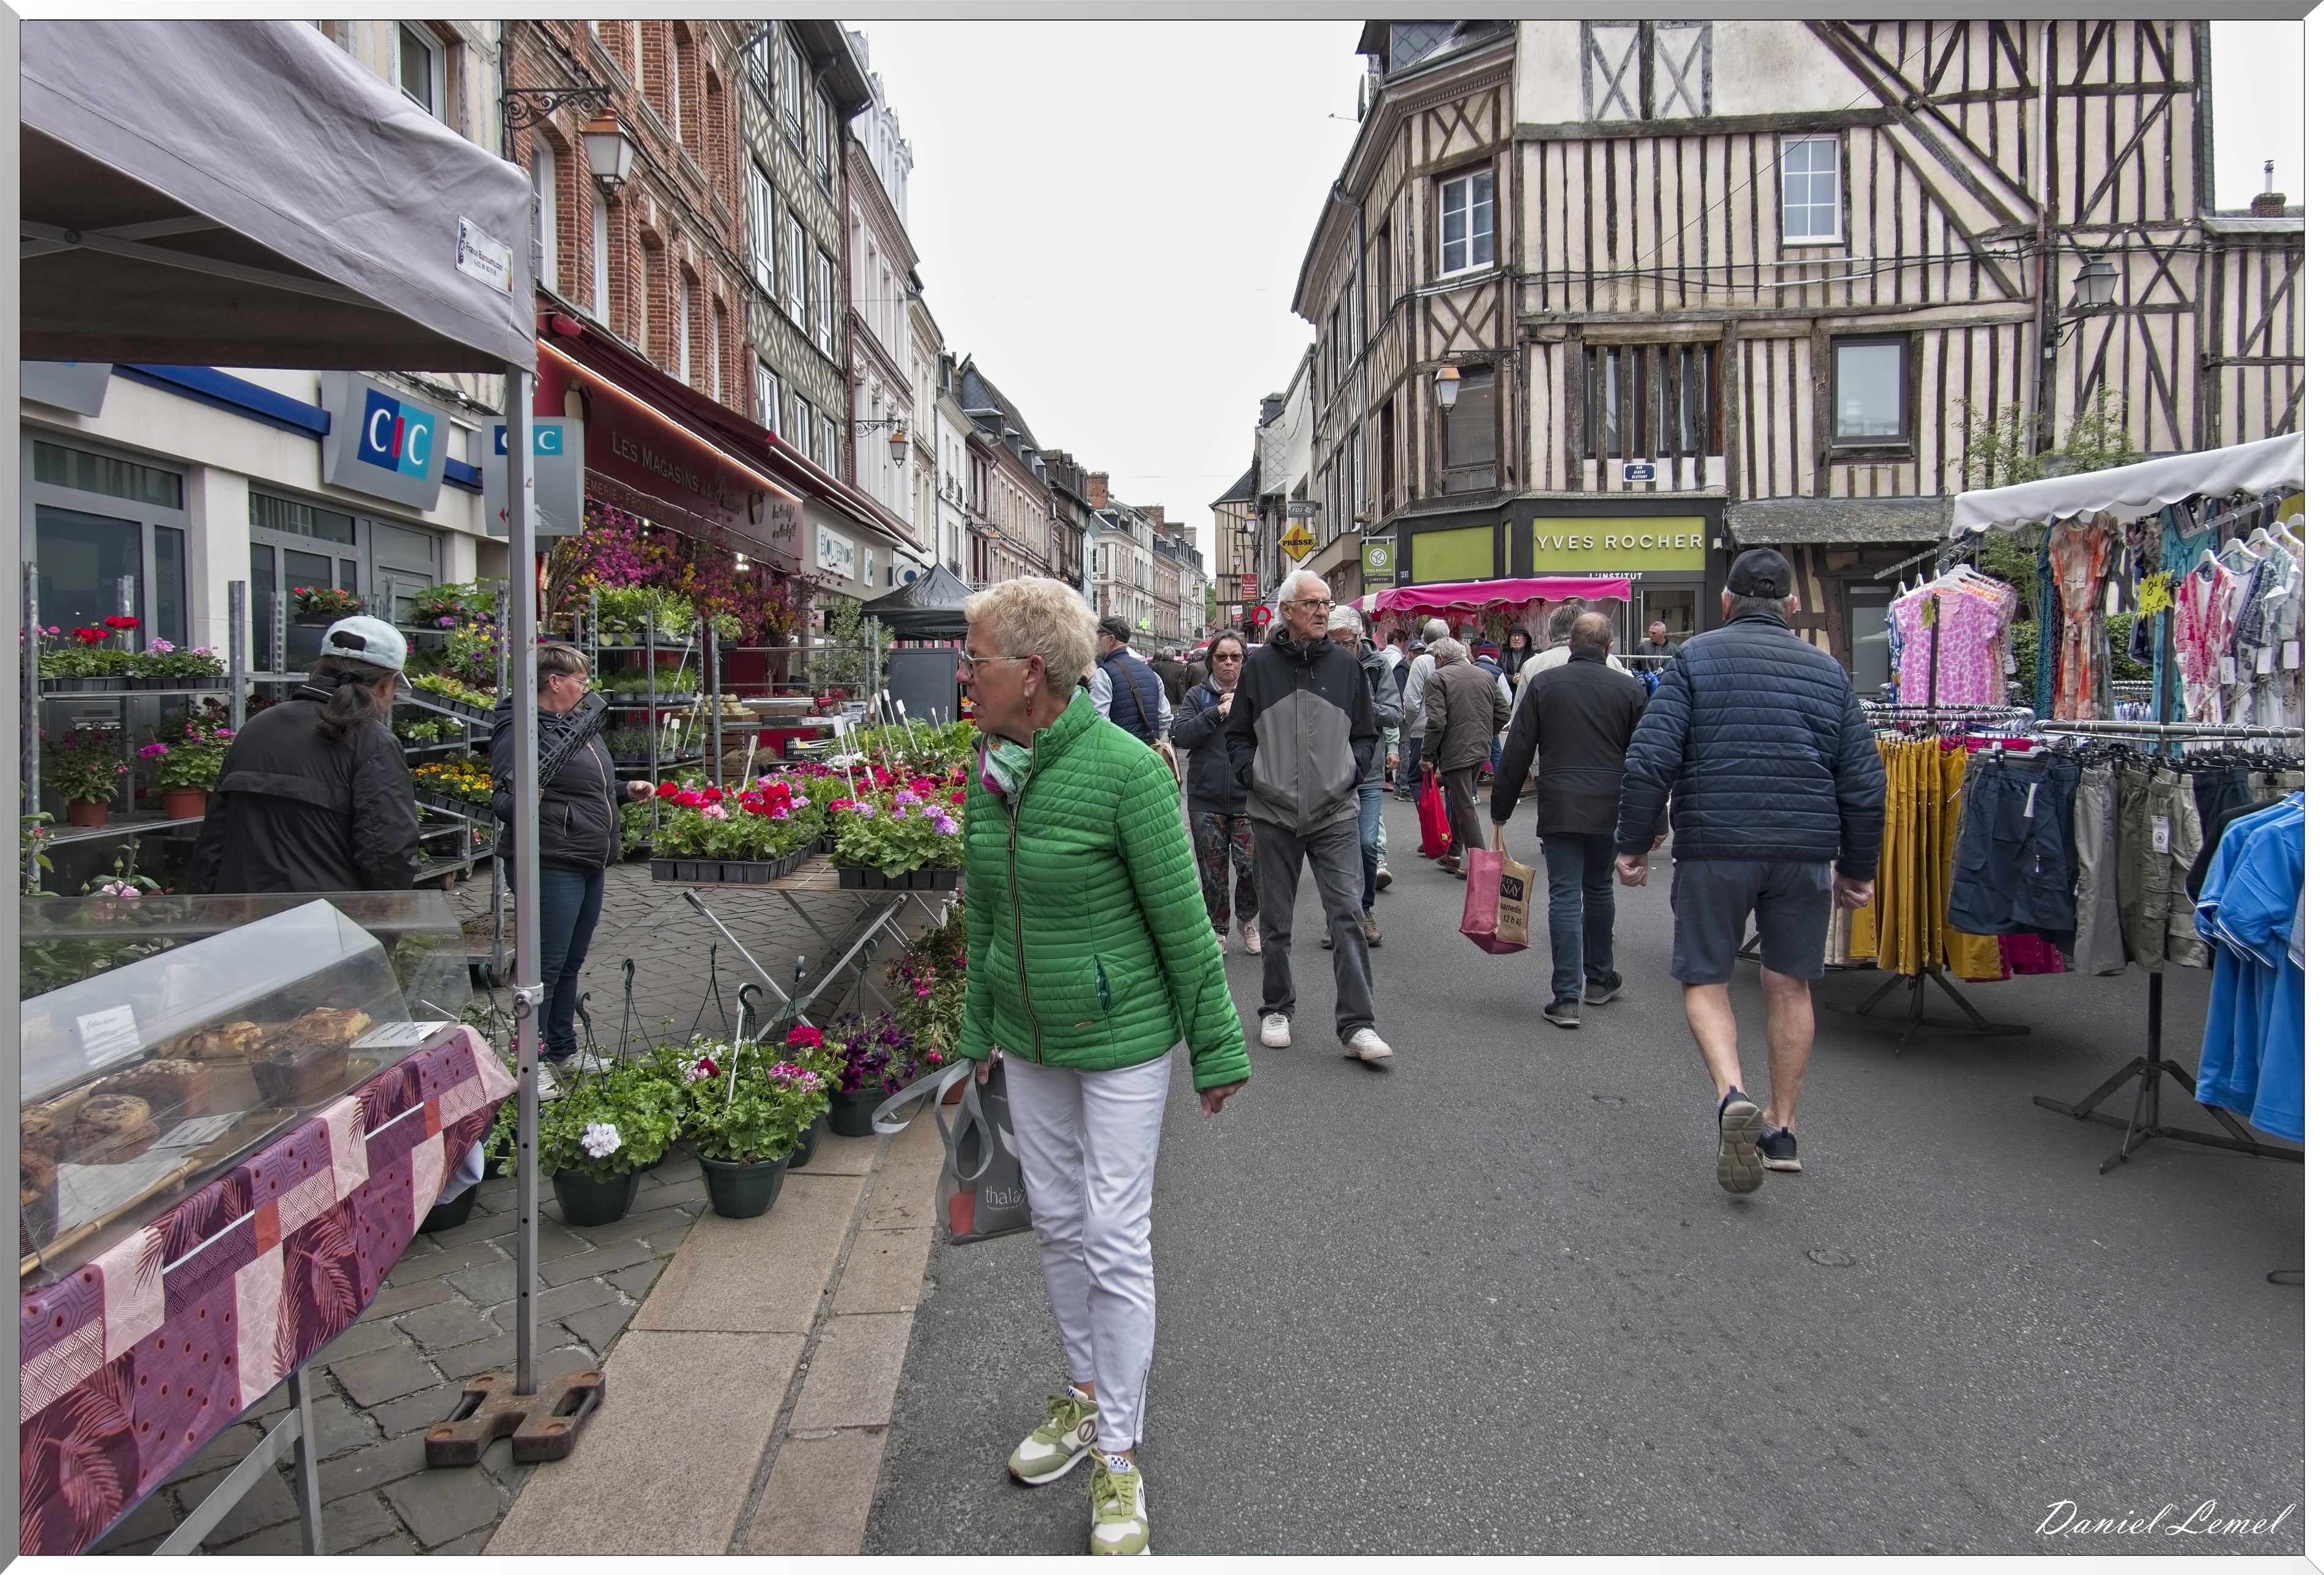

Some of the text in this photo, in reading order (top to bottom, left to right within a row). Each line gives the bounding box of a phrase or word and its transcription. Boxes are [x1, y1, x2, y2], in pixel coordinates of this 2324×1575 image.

[369, 409, 428, 465] CIC
[612, 431, 638, 462] LES
[642, 446, 698, 492] MAGASINS
[585, 474, 618, 501] ÉMERIE
[626, 493, 665, 519] FROMAGES
[1536, 534, 1703, 550] YVES ROCHER
[1500, 883, 1521, 897] NAY
[1503, 914, 1510, 923] 12
[1515, 917, 1522, 926] 45
